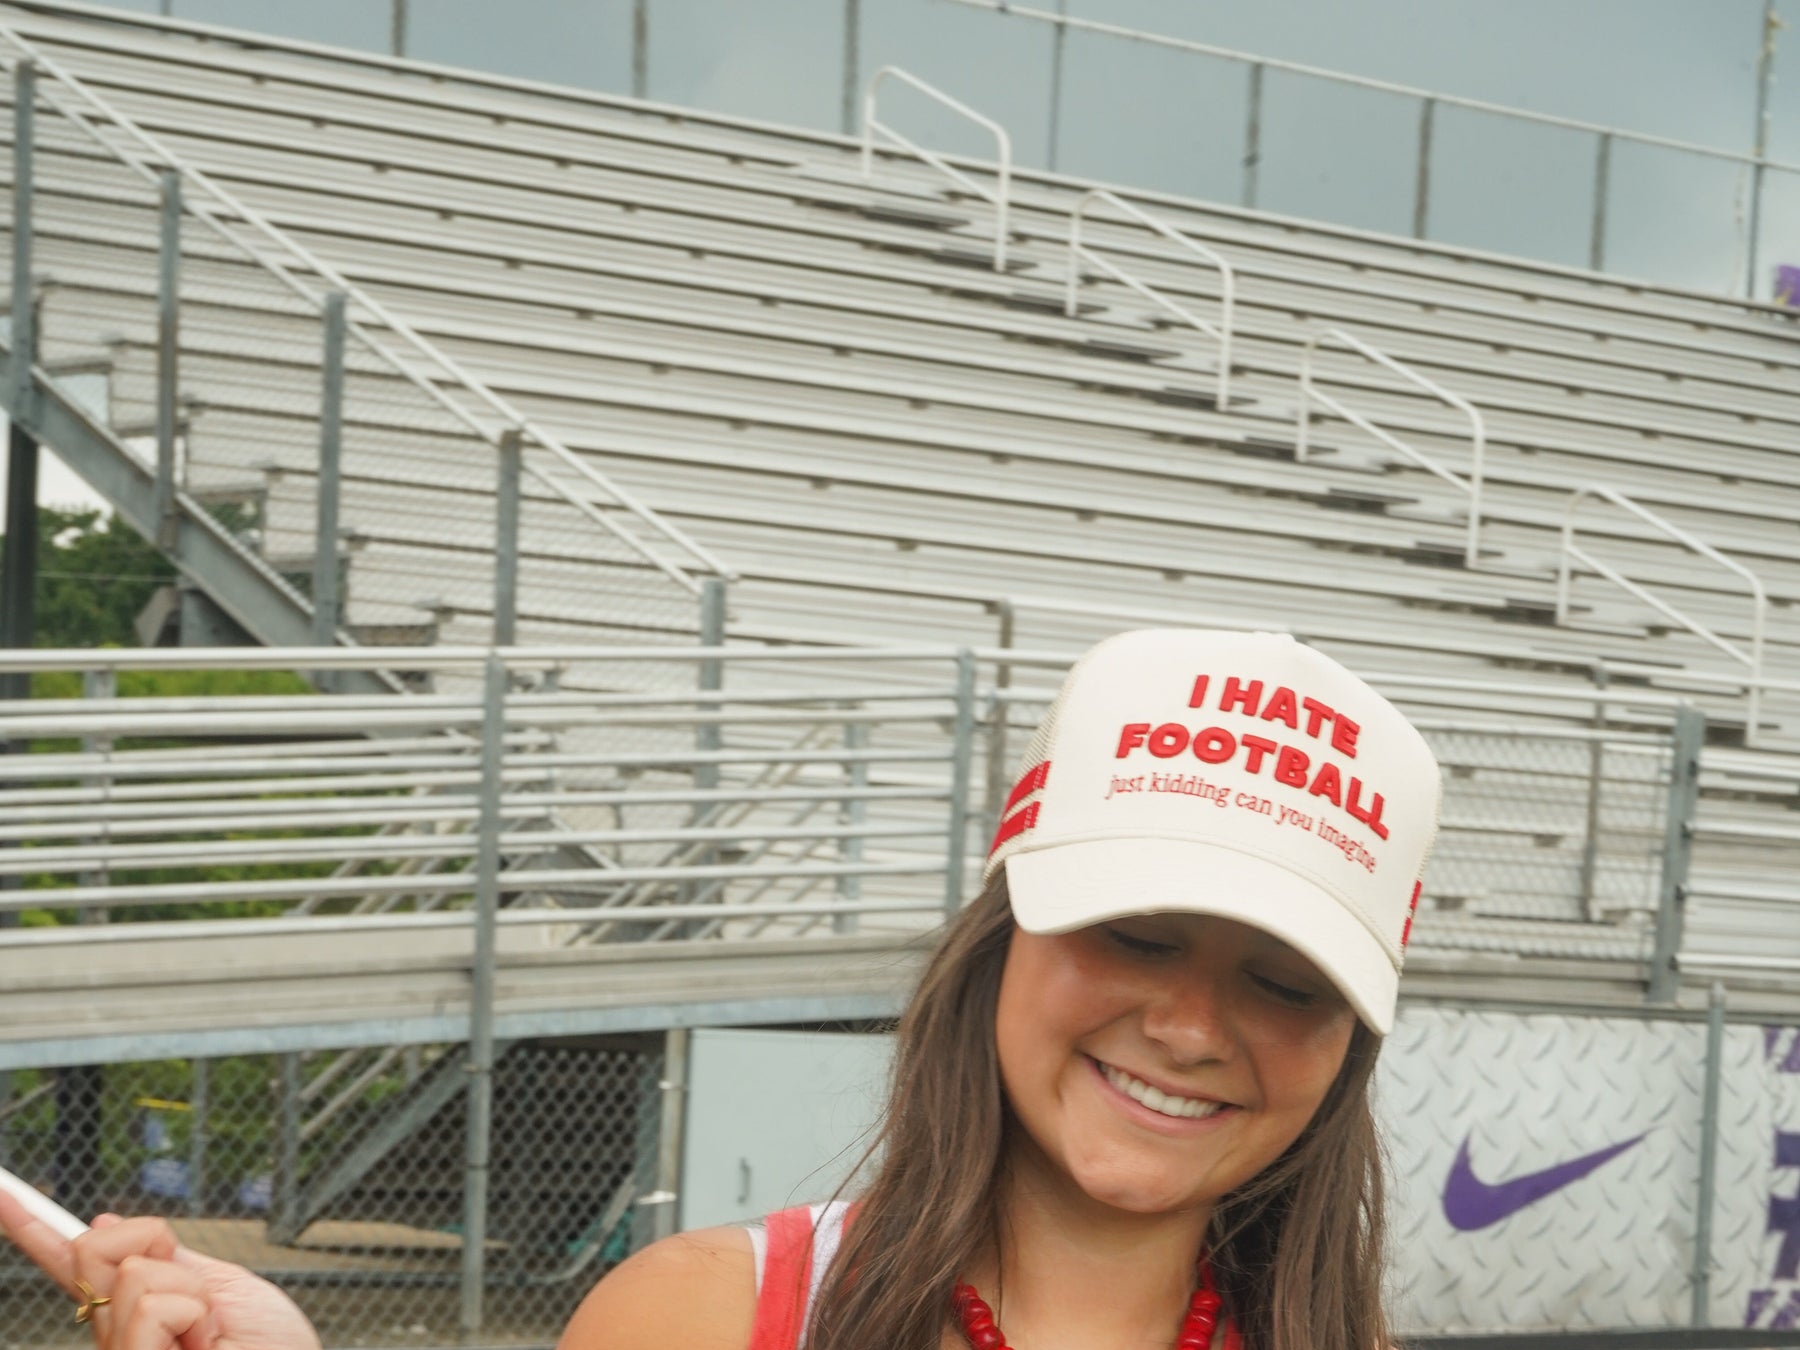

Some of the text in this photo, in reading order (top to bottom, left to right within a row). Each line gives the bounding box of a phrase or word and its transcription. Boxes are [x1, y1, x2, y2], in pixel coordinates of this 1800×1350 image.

[1187, 674, 1361, 760] I HATE
[1105, 772, 1377, 874] just kidding can you imagine
[1115, 722, 1390, 841] FOOTBALL
